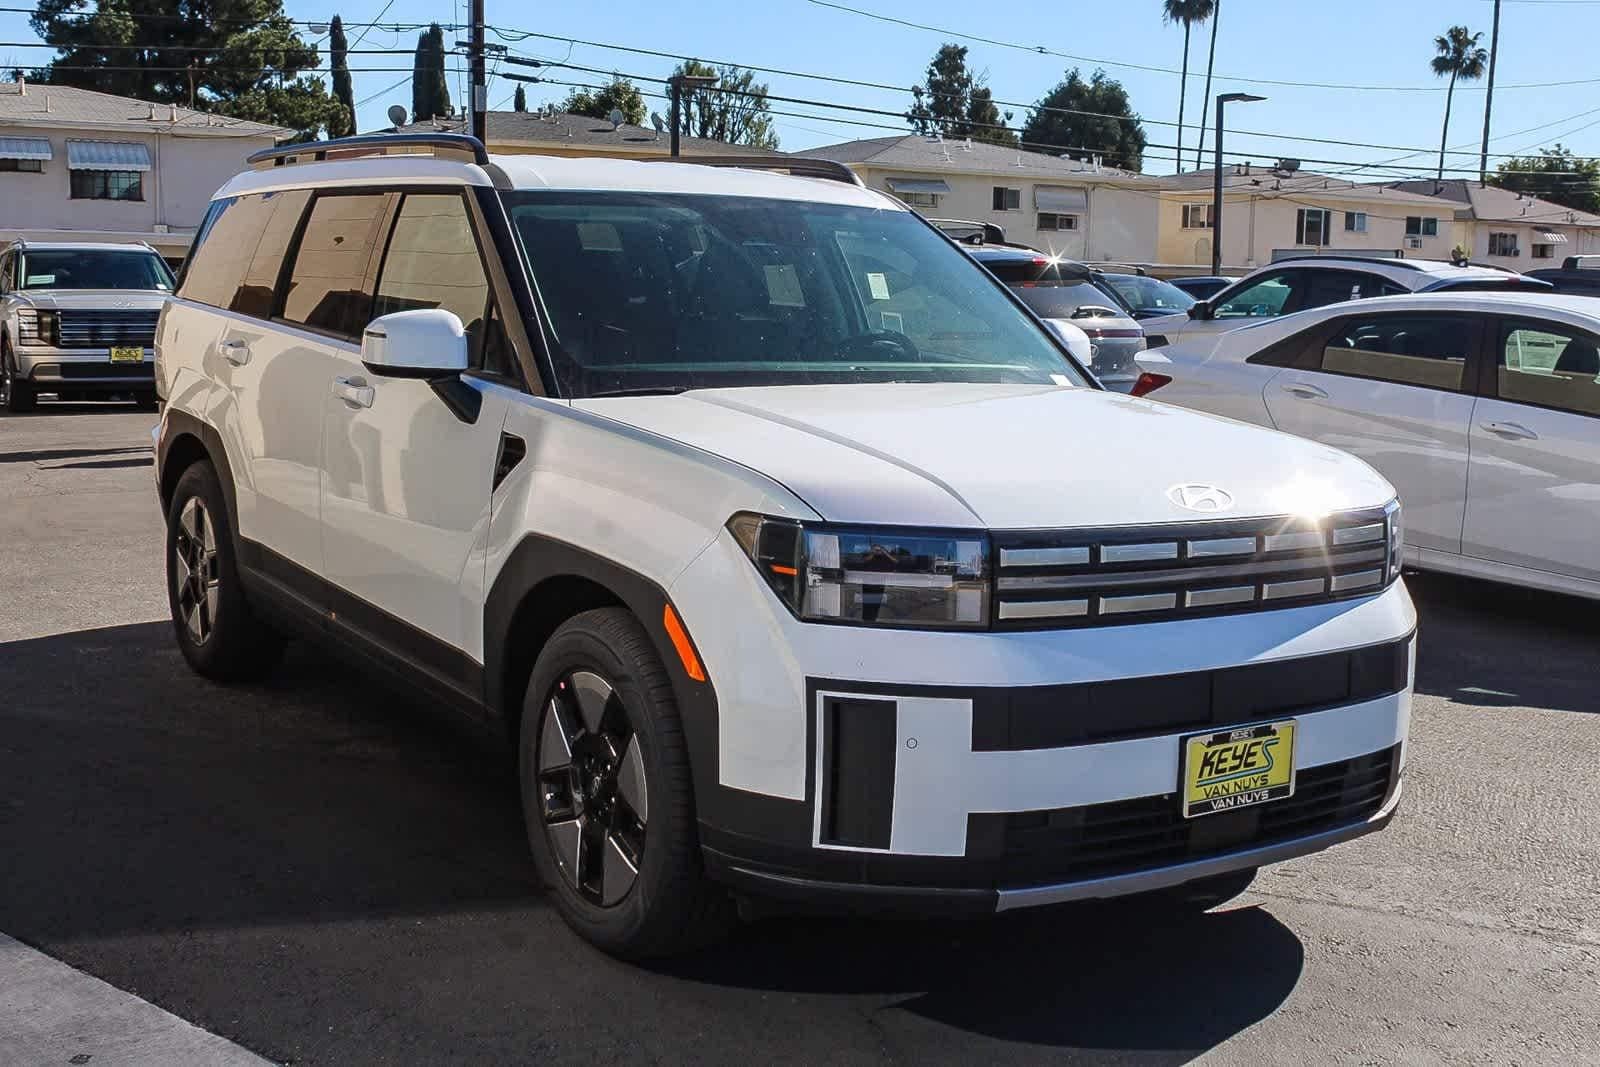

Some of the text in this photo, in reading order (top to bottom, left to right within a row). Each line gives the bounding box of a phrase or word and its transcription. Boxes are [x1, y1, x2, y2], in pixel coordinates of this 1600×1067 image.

[1198, 737, 1281, 779] KEYES
[1203, 774, 1269, 799] VAN NUYS
[1211, 789, 1270, 811] VAN NUYS
